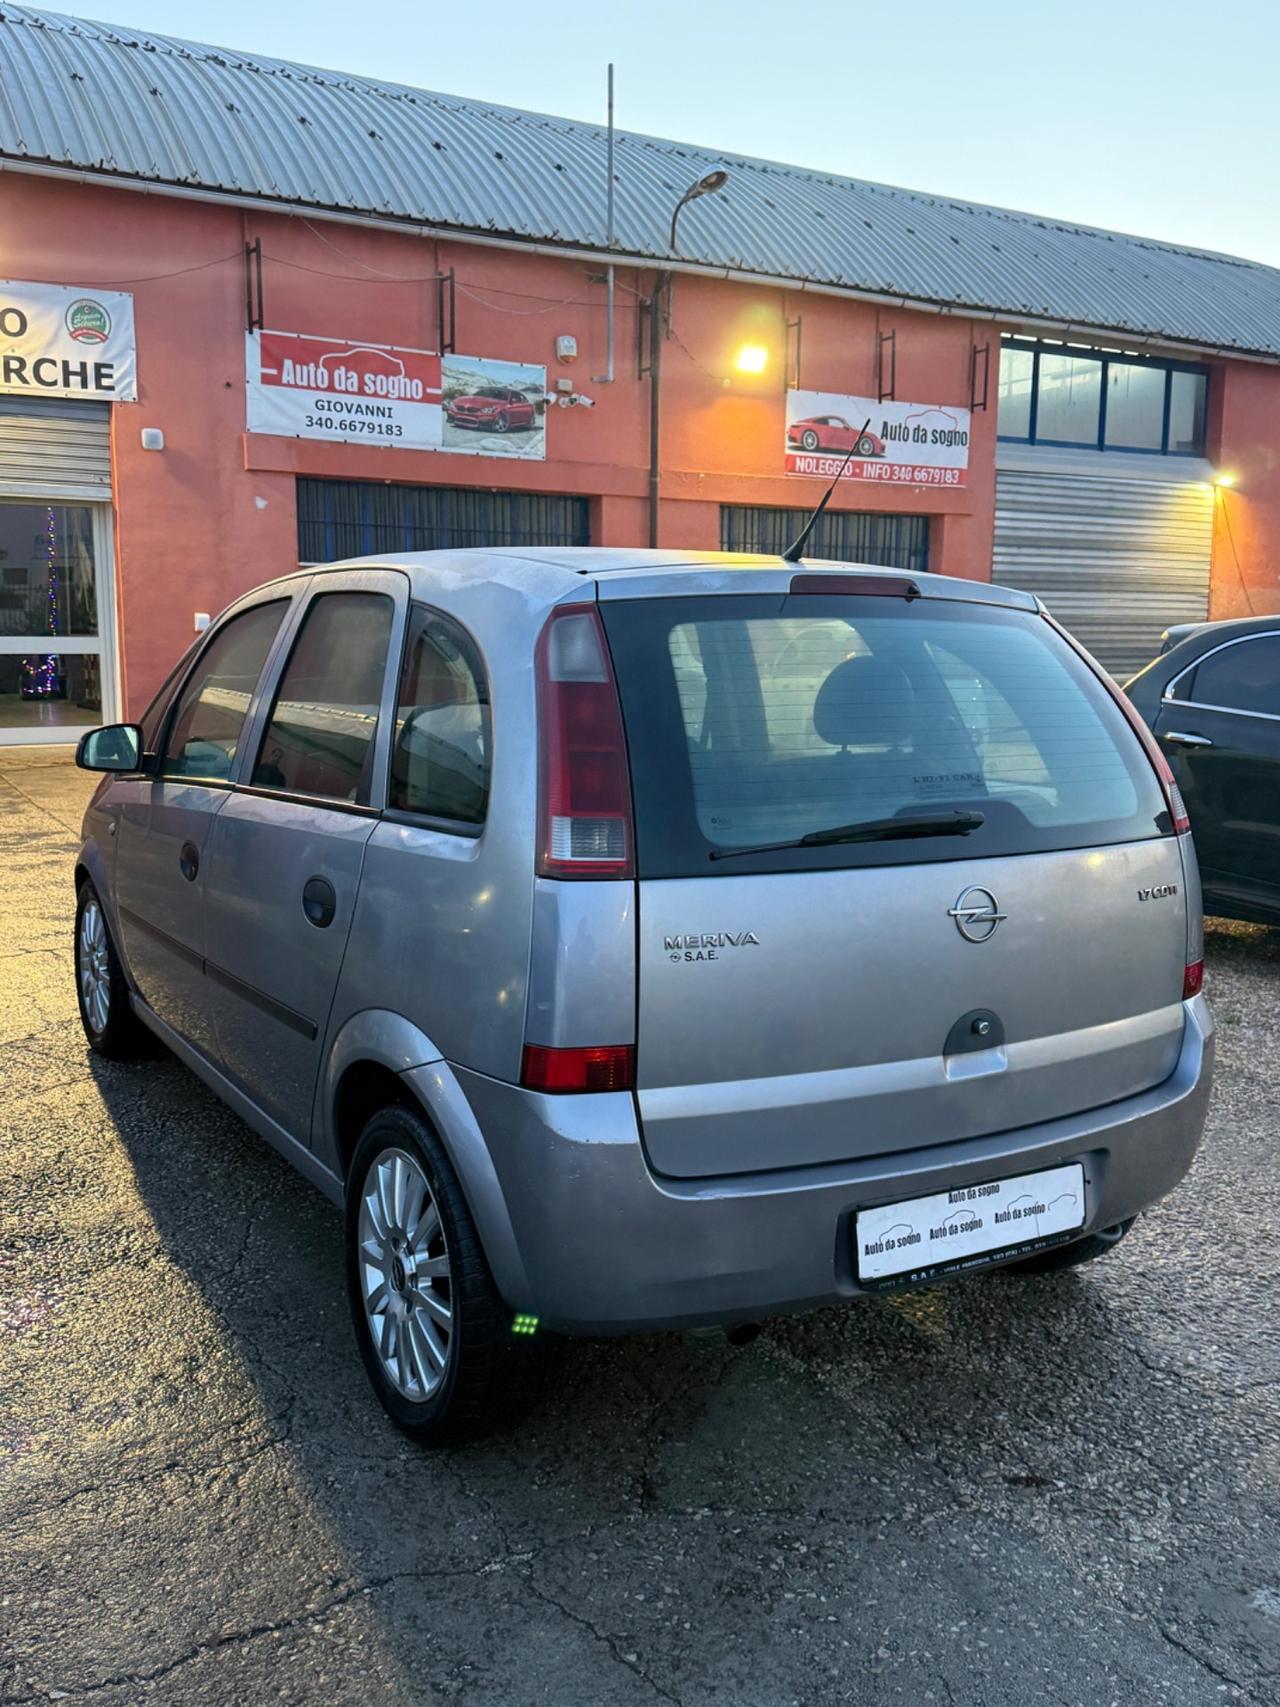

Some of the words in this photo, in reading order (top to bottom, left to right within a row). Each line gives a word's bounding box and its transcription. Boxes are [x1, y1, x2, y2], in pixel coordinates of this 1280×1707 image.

[0, 307, 28, 337] O
[3, 355, 116, 391] RCHE
[282, 358, 329, 389] Auto
[333, 366, 359, 393] da
[363, 373, 423, 400] sogno
[315, 399, 393, 418] GIOVANNI
[305, 415, 403, 437] 340.6679183
[881, 421, 910, 442] Auto
[913, 424, 928, 444] da
[931, 429, 968, 447] sogno
[863, 463, 890, 479] INFO
[892, 466, 912, 480] 340
[913, 467, 960, 484] 6679183
[664, 932, 760, 950] MERIVA
[684, 950, 719, 962] S.A.E.
[948, 1190, 966, 1204] Auto
[967, 1188, 977, 1200] da
[978, 1184, 1000, 1198] sogno
[994, 1210, 1012, 1224] Auto
[1012, 1208, 1022, 1220] da
[929, 1225, 947, 1240] Auto
[948, 1223, 959, 1236] da
[960, 1218, 983, 1233] sogno
[864, 1242, 884, 1256] Auto
[885, 1239, 896, 1252] da
